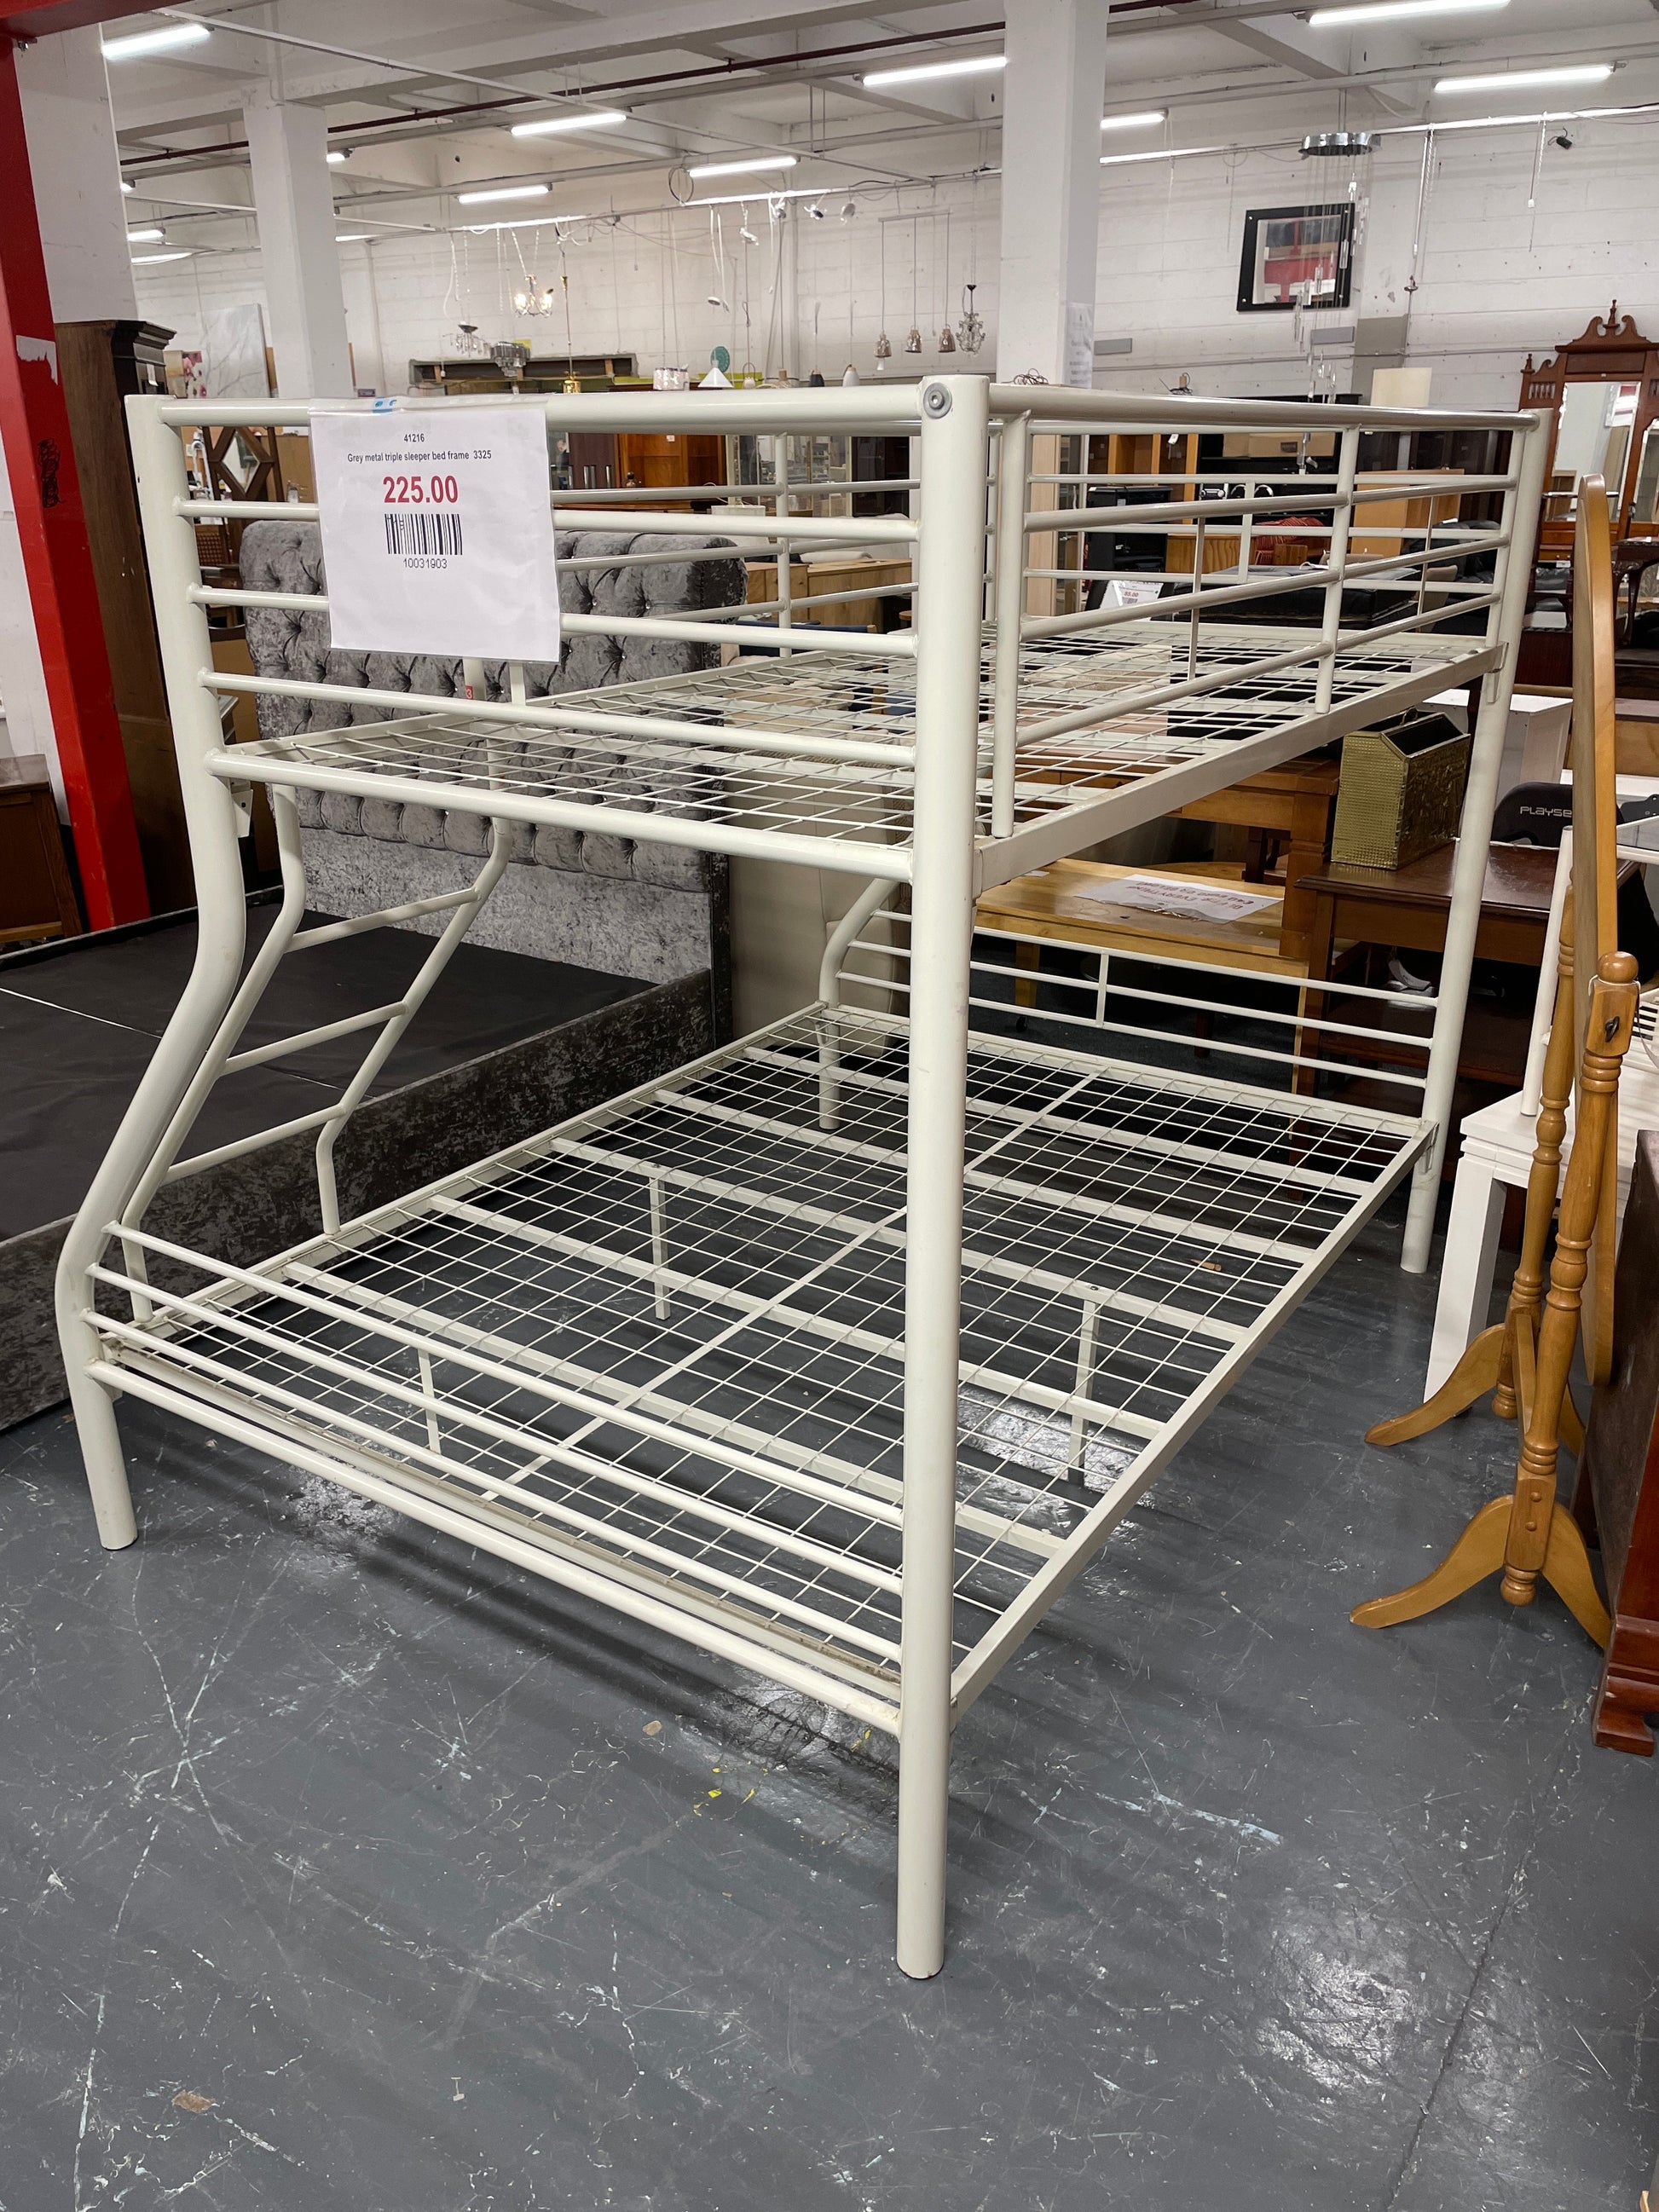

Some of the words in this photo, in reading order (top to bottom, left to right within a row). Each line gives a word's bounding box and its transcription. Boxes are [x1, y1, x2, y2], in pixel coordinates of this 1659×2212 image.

[403, 433, 425, 442] 41216
[347, 453, 363, 464] Grey
[365, 453, 384, 462] metal
[384, 452, 403, 463] triple
[404, 452, 431, 463] sleeper
[431, 451, 446, 460] bed
[448, 450, 470, 460] frame
[473, 449, 492, 459] 3325
[383, 475, 459, 504] 225.00
[402, 557, 448, 569] 10031903
